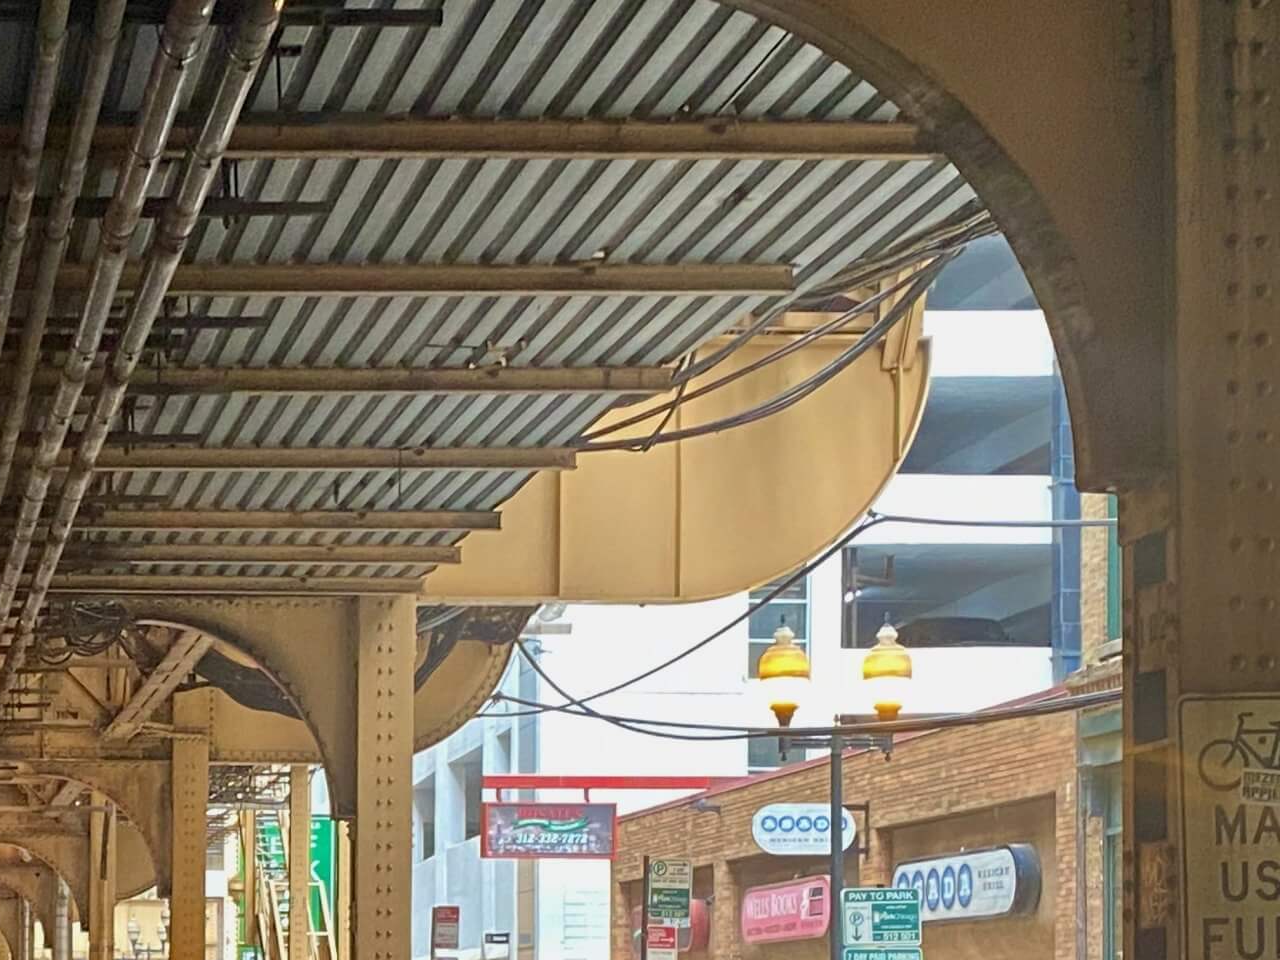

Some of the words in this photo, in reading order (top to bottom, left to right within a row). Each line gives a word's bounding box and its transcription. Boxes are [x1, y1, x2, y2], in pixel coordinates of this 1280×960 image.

[848, 892, 867, 901] PAY
[870, 892, 884, 900] TO
[886, 891, 913, 900] PARK
[1202, 917, 1280, 960] FU
